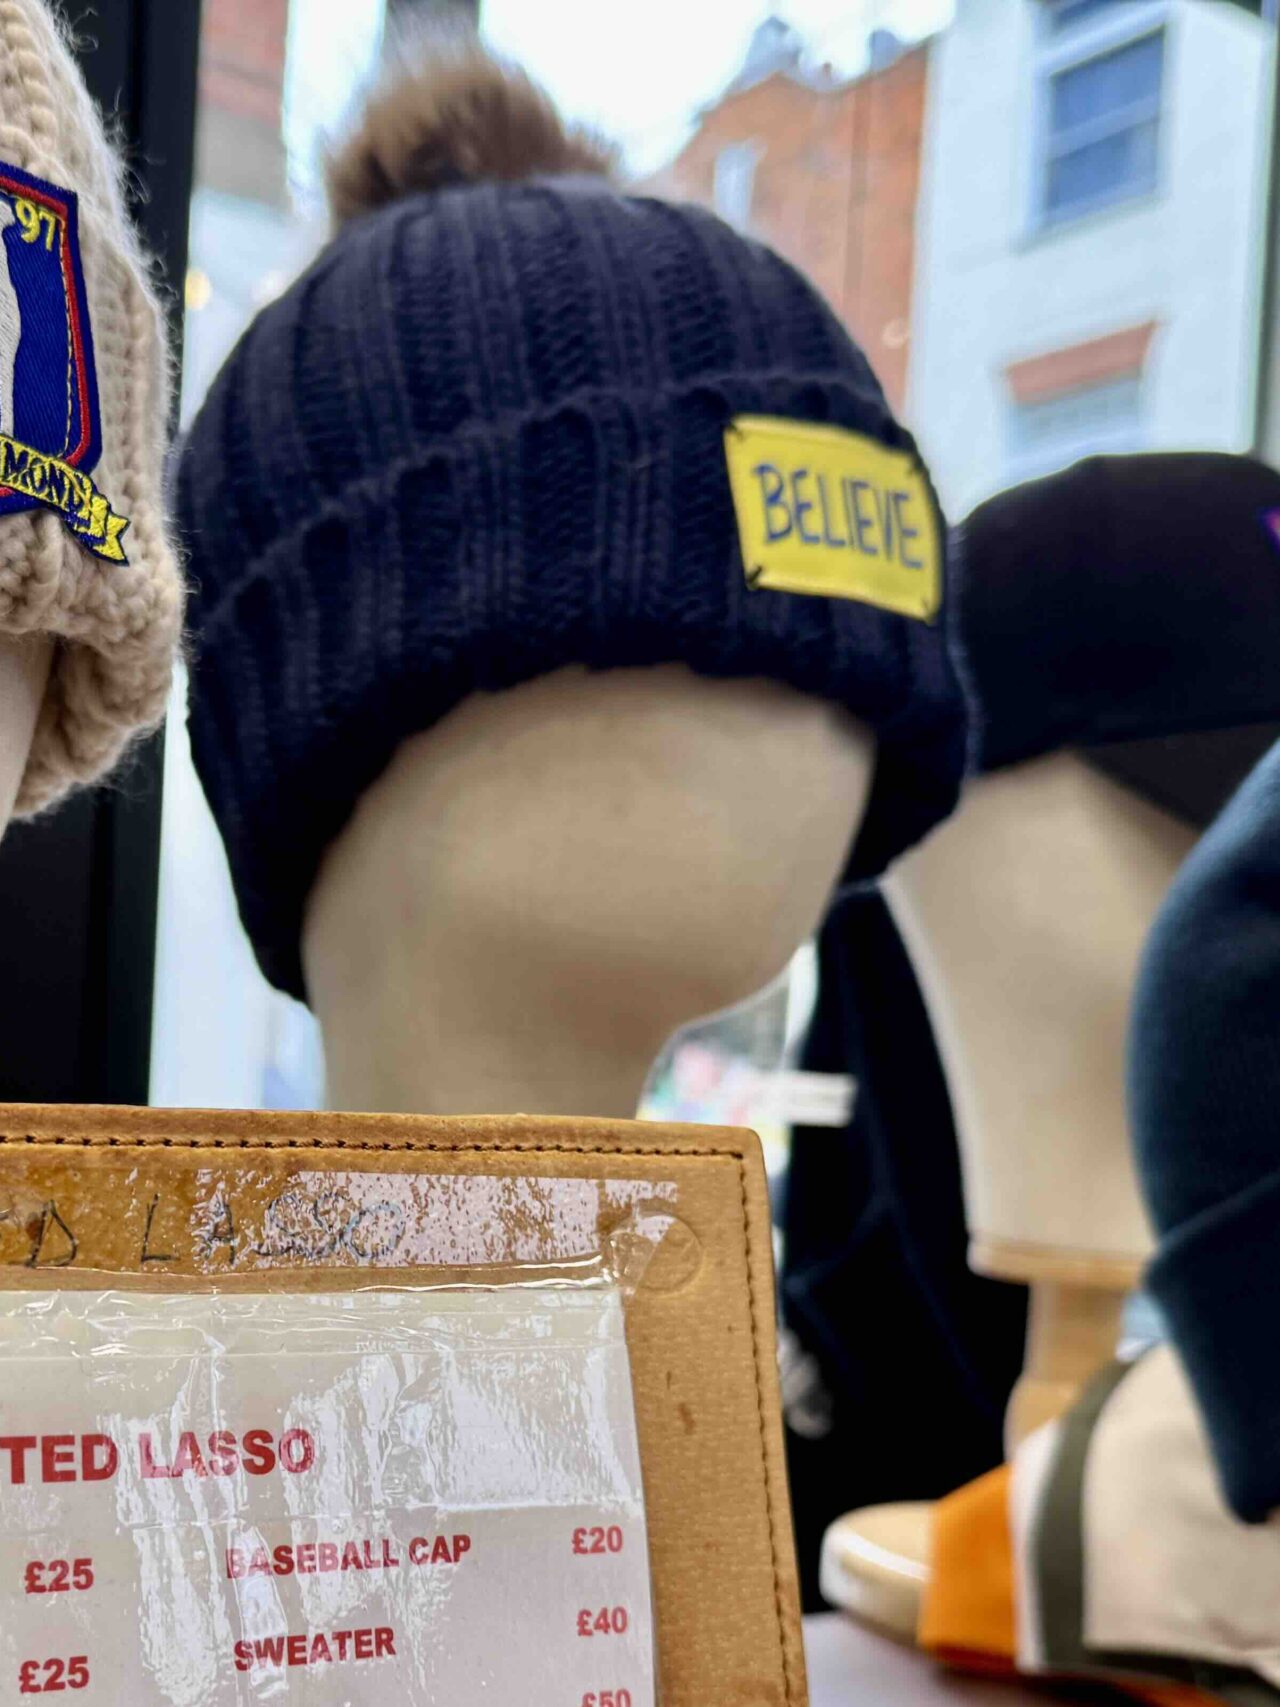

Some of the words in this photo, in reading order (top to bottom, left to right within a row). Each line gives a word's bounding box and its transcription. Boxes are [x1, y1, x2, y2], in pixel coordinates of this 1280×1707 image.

[15, 199, 58, 252] 97
[752, 462, 926, 571] BELIEVE
[139, 1192, 406, 1265] LASSO
[137, 1427, 317, 1480] LASSO
[23, 1557, 95, 1595] £25
[224, 1537, 401, 1580] BASEBALL
[407, 1533, 472, 1566] CAP
[571, 1524, 624, 1555] £20
[233, 1626, 397, 1672] SWEATER
[576, 1605, 629, 1637] £40
[18, 1655, 91, 1694] £25
